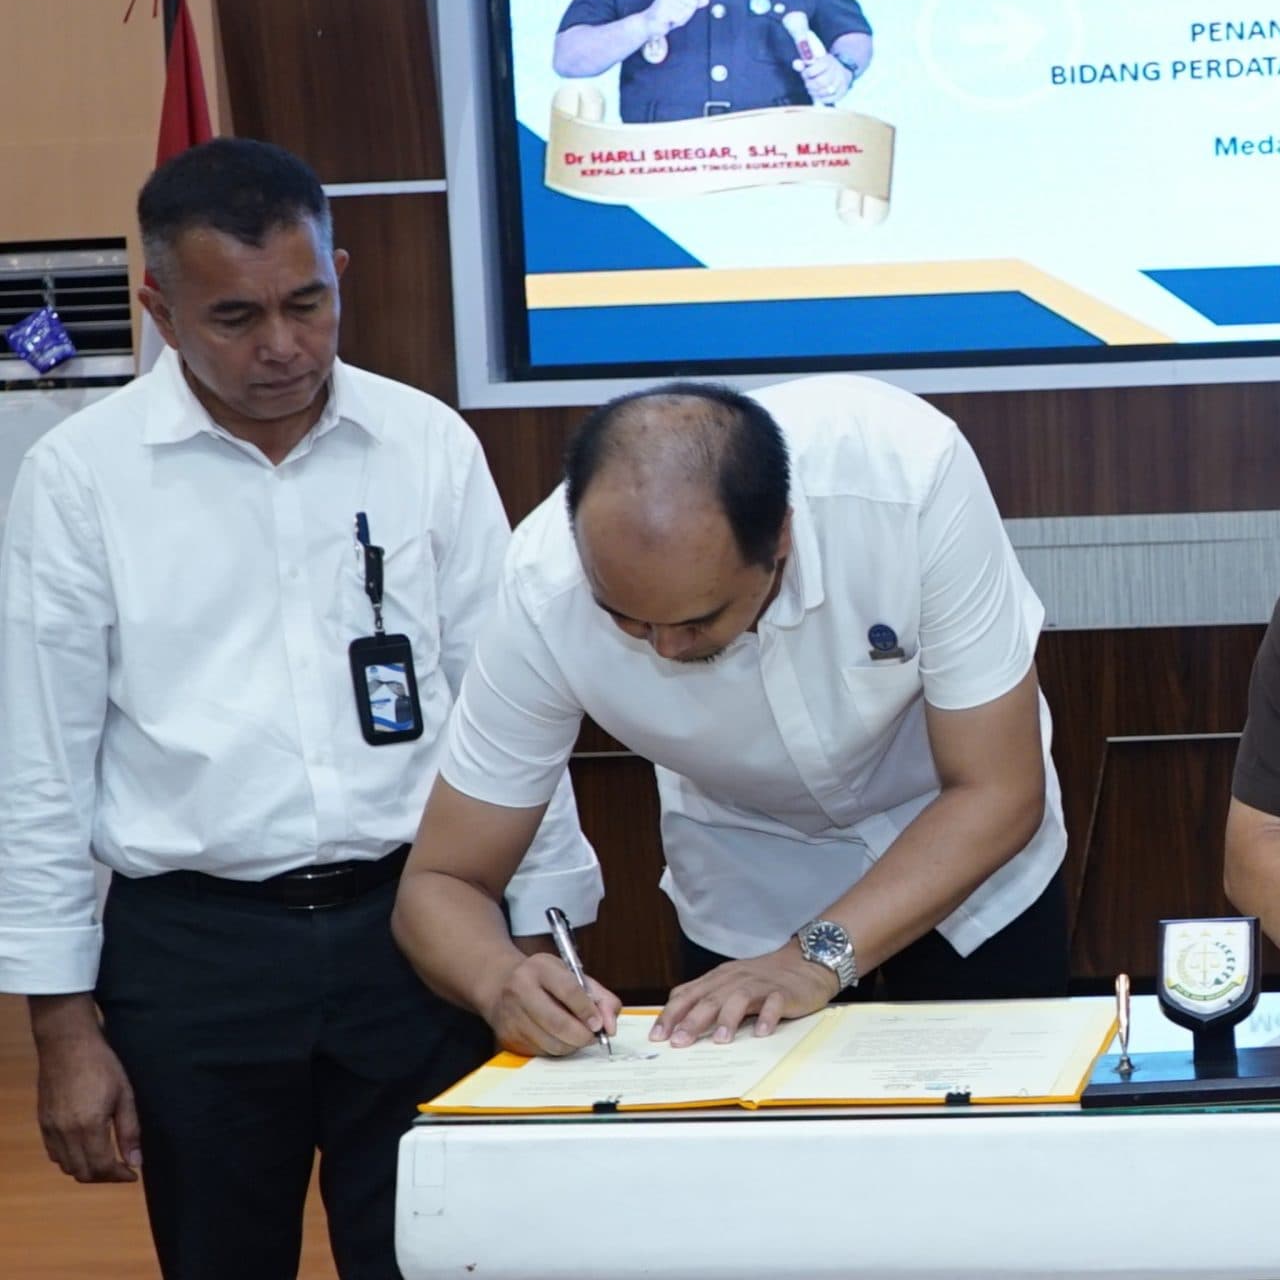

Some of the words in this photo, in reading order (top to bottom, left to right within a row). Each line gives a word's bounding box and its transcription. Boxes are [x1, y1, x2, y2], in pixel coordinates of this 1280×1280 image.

[1052, 62, 1161, 84] BIDANG
[565, 152, 584, 165] Dr
[591, 149, 646, 164] HARLI
[654, 147, 737, 160] SIREGAR,
[581, 167, 625, 176] KEPALA
[811, 159, 850, 168] UTARA
